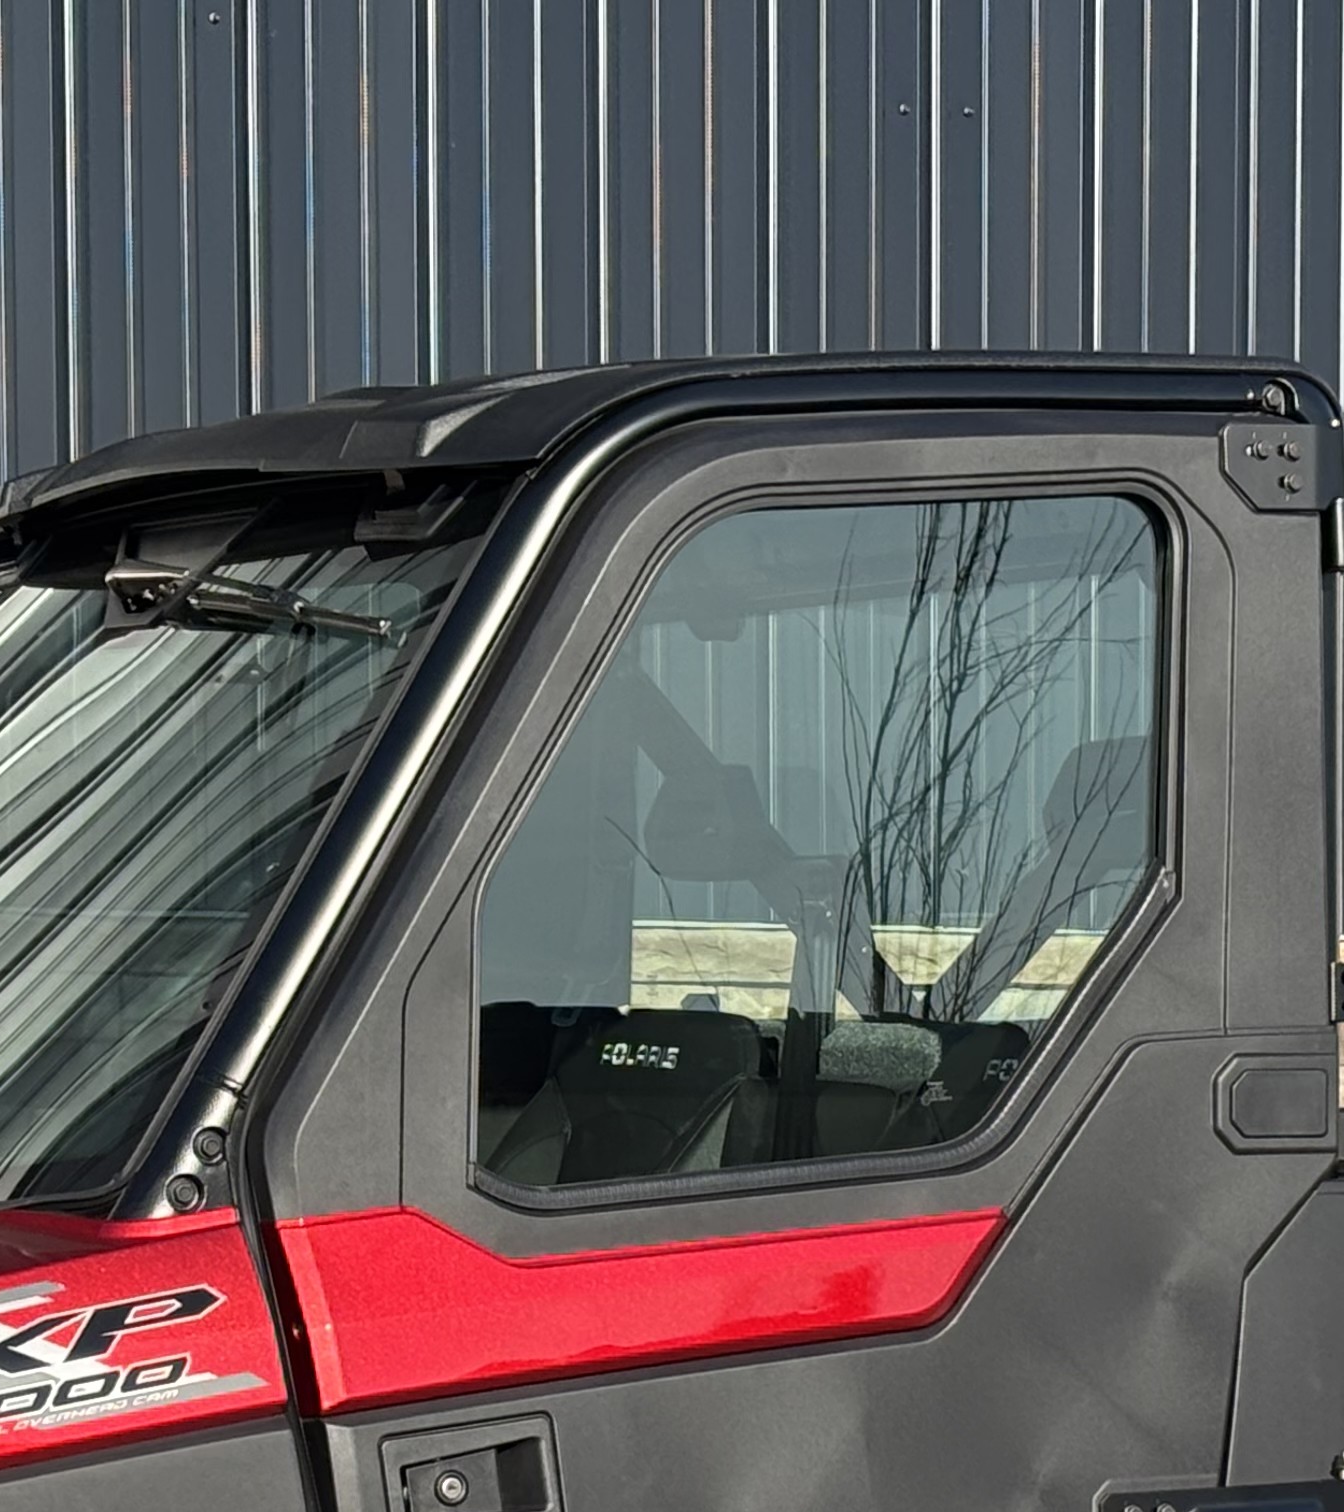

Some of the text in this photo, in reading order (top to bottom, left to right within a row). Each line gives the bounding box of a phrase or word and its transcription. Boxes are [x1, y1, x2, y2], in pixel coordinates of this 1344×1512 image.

[599, 1042, 680, 1070] POLARIS
[14, 1400, 127, 1431] OVERHEAD
[133, 1389, 180, 1406] CAM
